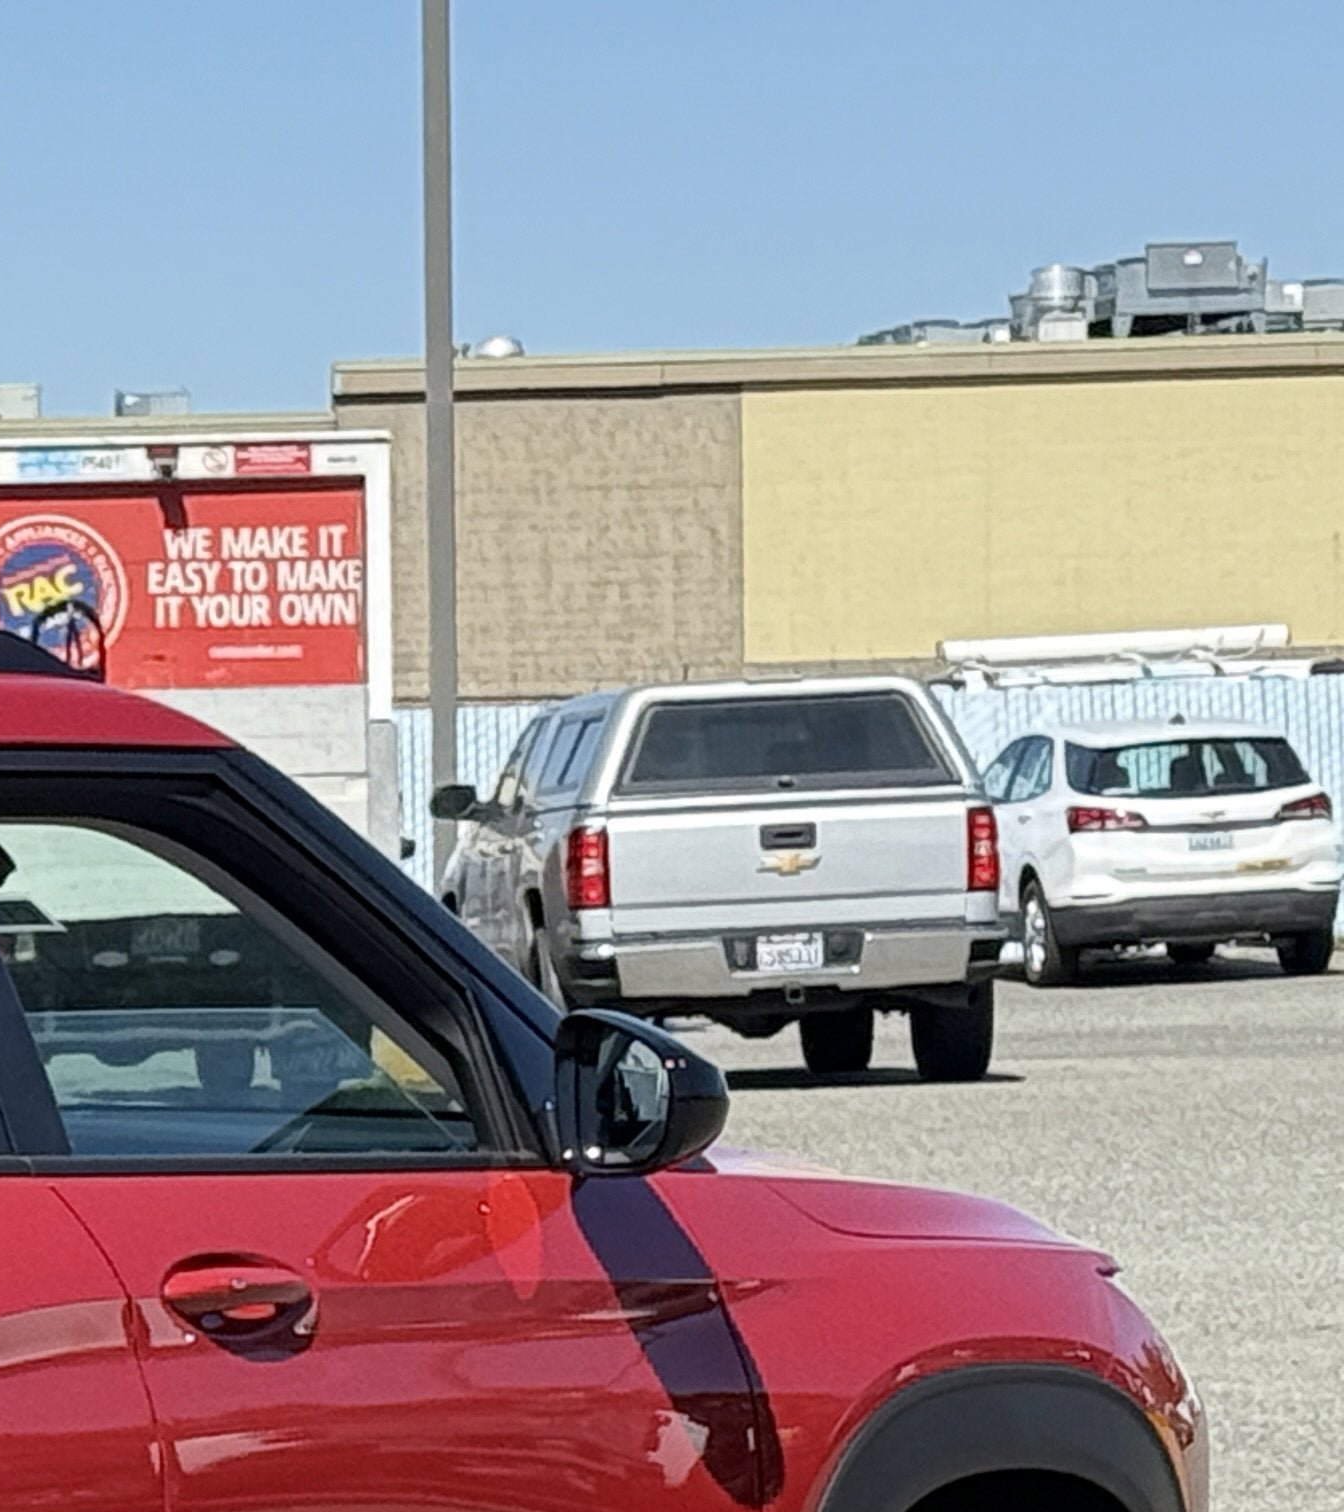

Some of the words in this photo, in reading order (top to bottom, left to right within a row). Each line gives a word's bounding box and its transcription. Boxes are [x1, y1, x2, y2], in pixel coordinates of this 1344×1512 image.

[163, 526, 213, 560] WE
[220, 525, 310, 560] MAKE
[318, 524, 348, 558] IT
[0, 563, 85, 617] RAC
[147, 560, 222, 595] EASY
[227, 560, 268, 594] TO
[276, 558, 362, 592] MAKE
[154, 596, 185, 629] IT
[190, 593, 272, 629] YOUR
[279, 593, 357, 627] OWN
